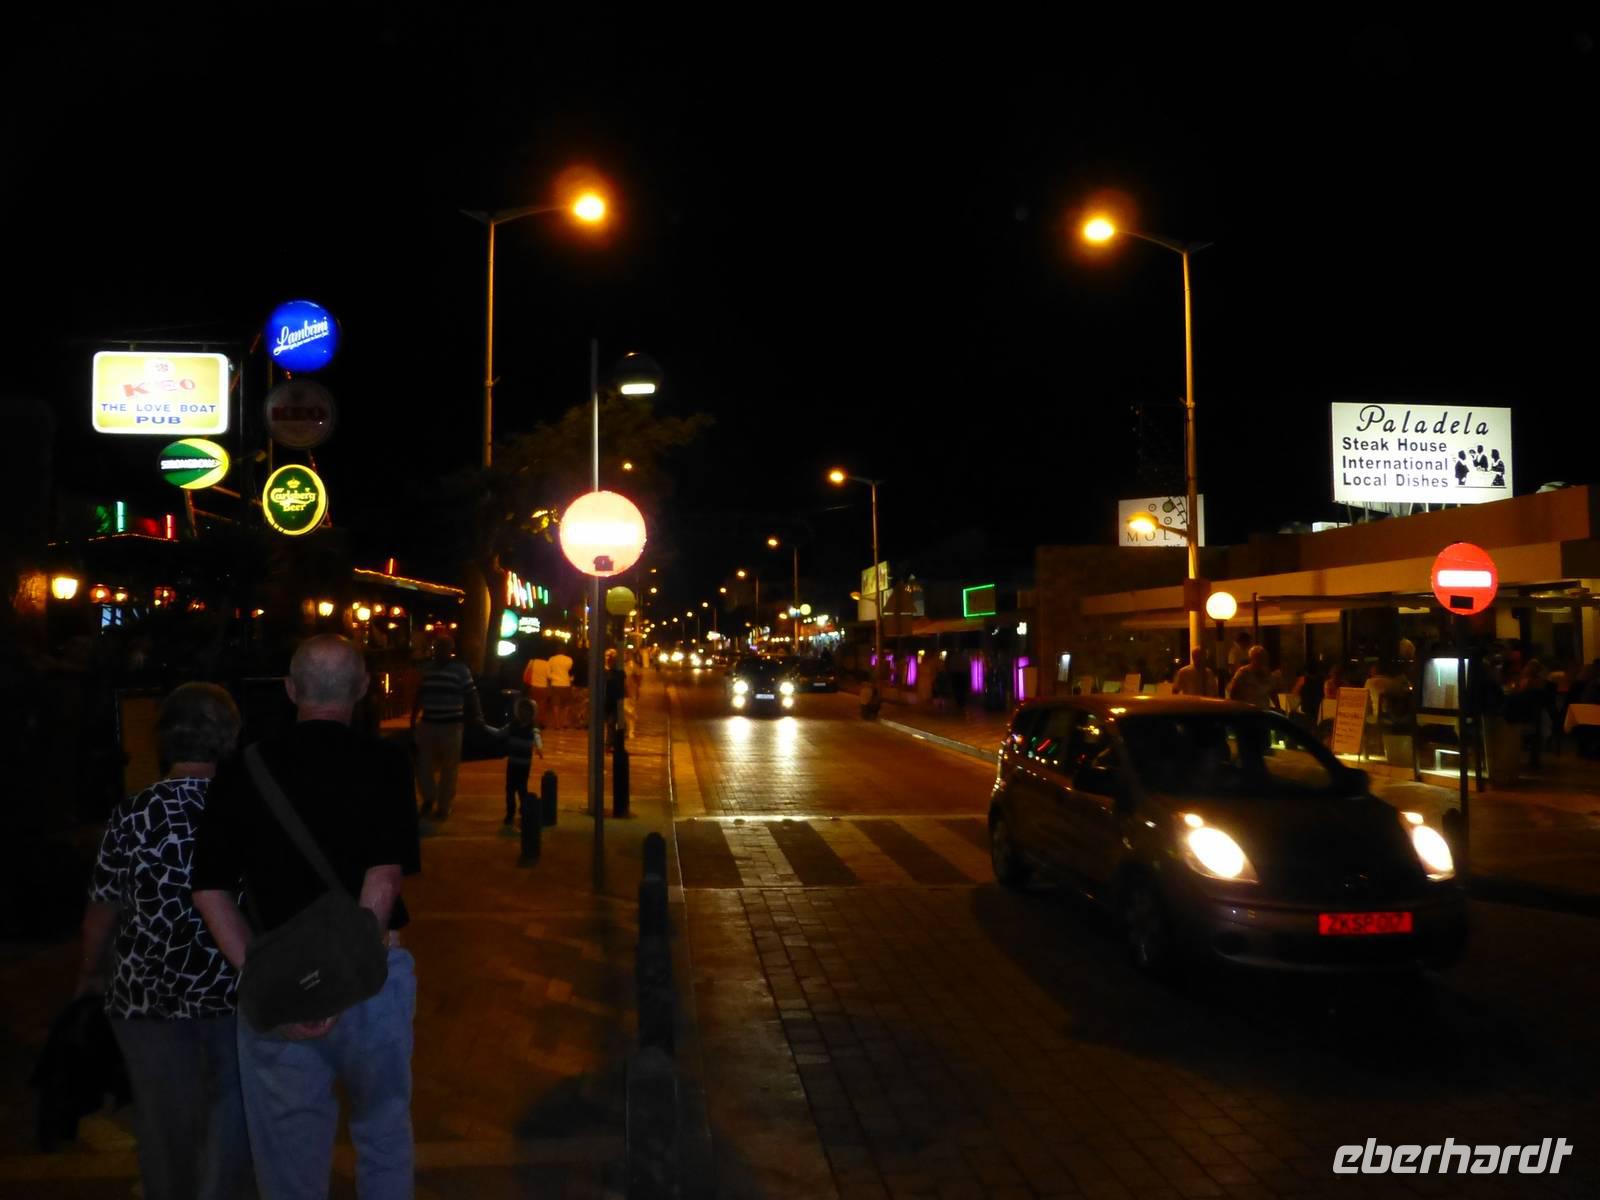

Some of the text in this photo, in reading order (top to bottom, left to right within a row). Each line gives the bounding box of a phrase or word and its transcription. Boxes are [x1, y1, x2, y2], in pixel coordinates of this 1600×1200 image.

[101, 403, 216, 413] THE LOVE BOAT
[135, 415, 182, 425] PUB
[1356, 404, 1489, 435] Paladela
[1342, 436, 1447, 452] Steak House
[1342, 454, 1448, 471] International
[1342, 472, 1449, 488] Local Dishes
